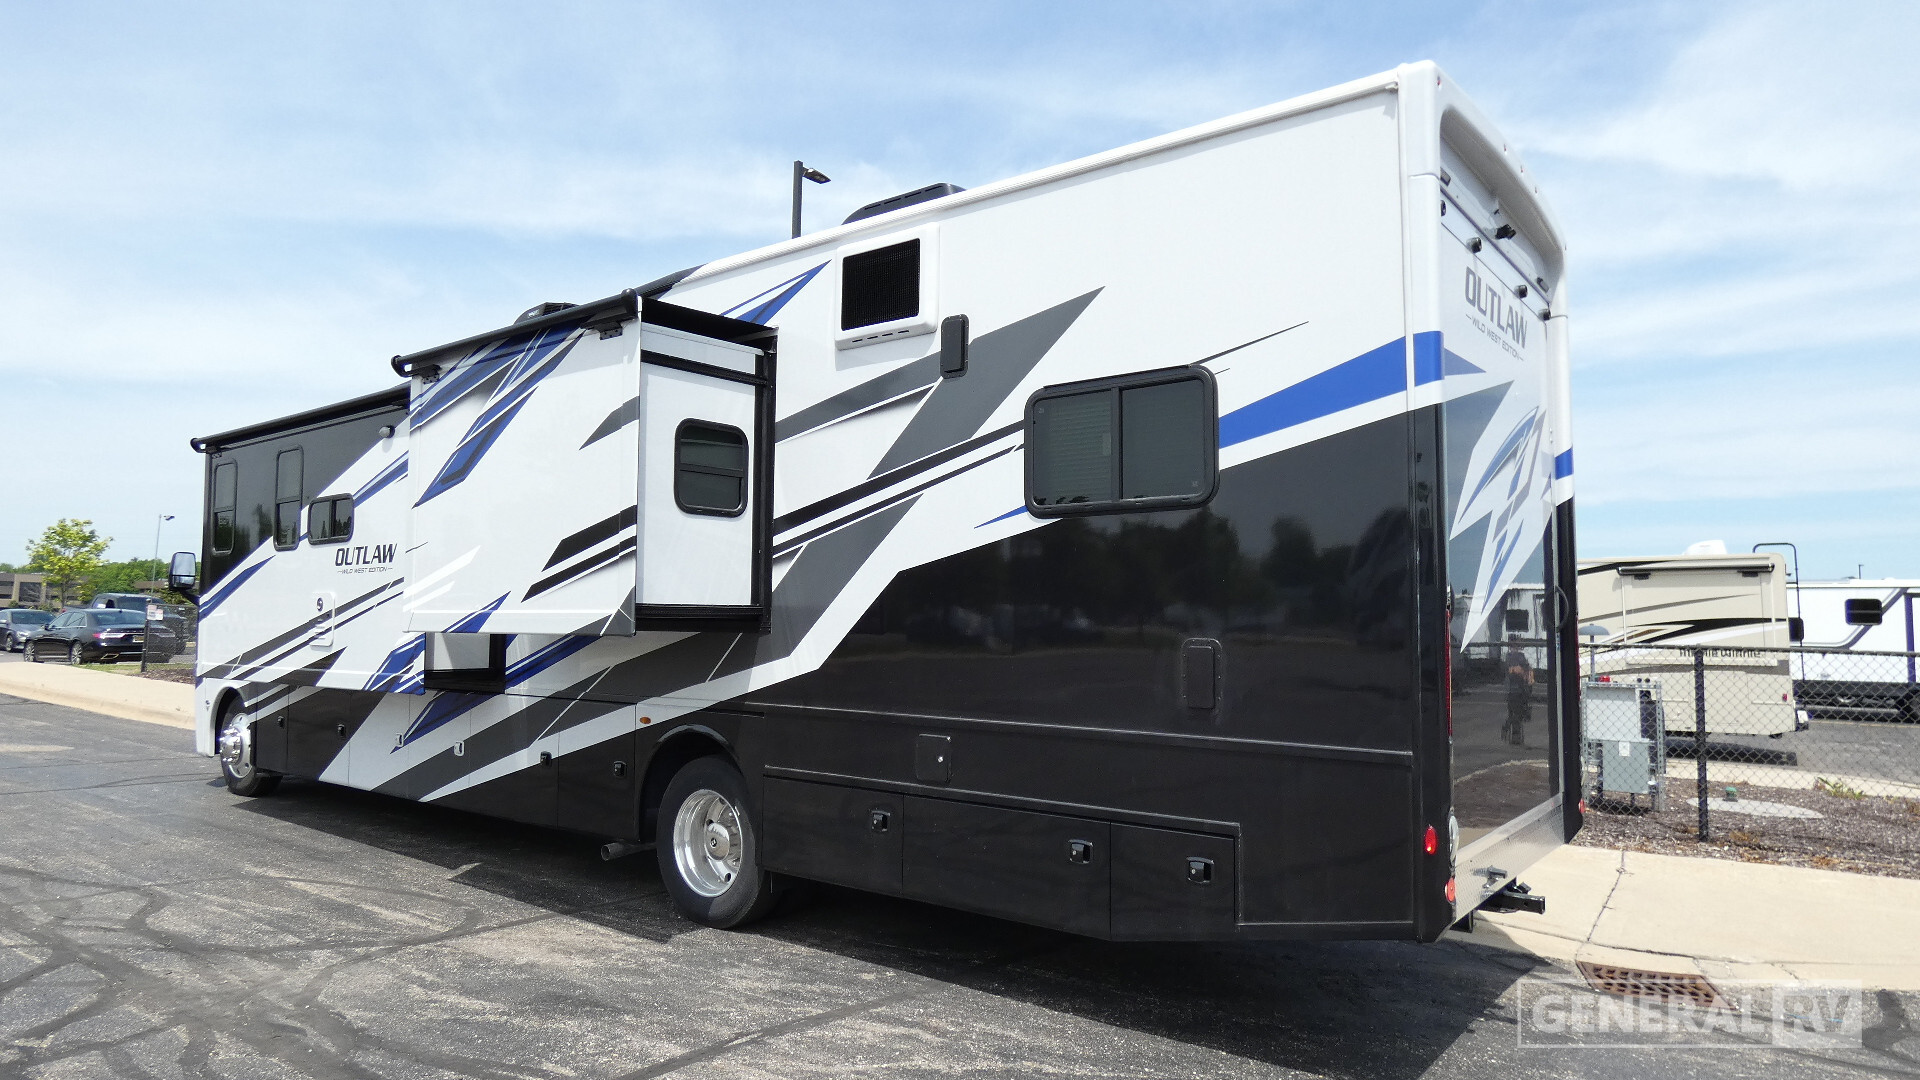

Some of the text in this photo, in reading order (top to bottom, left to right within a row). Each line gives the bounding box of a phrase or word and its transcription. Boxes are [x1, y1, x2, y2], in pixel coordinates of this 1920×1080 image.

[1464, 266, 1528, 349] OUTLAW
[1472, 318, 1486, 334] WILD
[1486, 328, 1502, 345] WEST
[335, 543, 398, 566] OUTLAW
